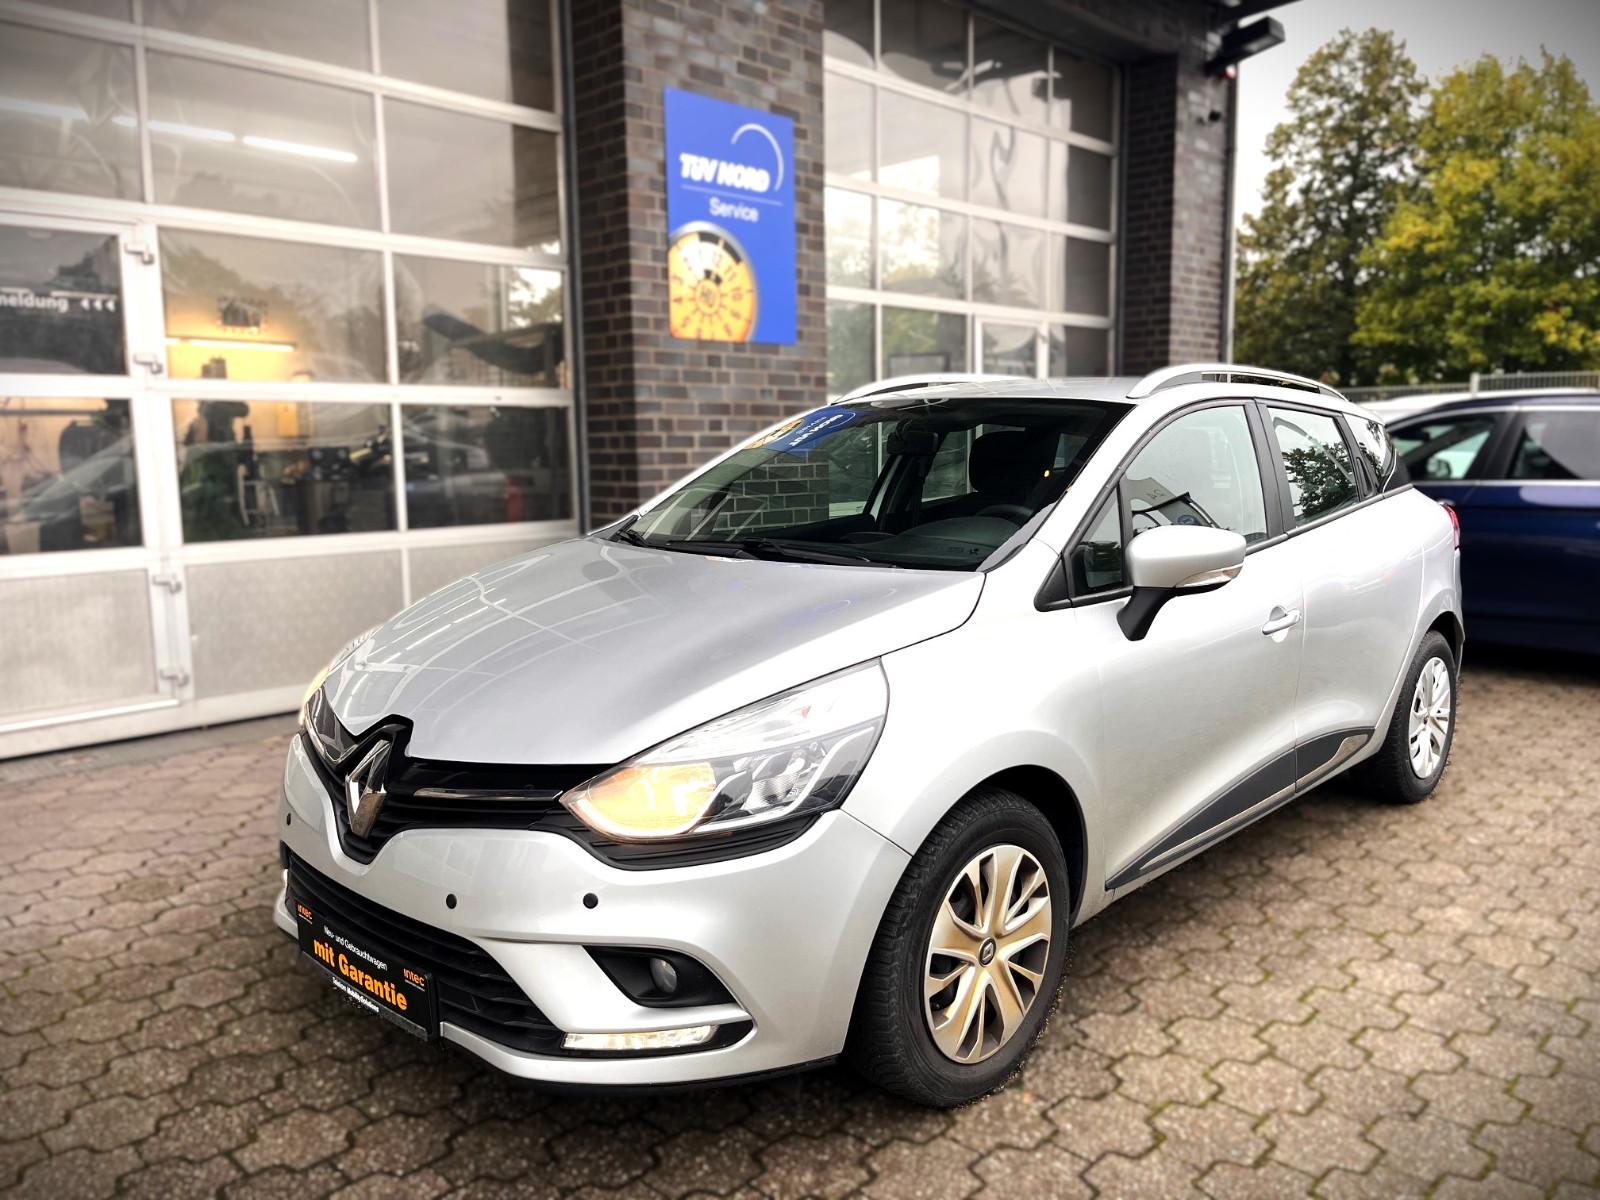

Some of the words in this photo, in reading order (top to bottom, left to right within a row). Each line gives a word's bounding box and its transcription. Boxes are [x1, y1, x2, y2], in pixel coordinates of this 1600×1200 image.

[717, 162, 770, 192] NORD
[709, 197, 759, 222] Service
[313, 938, 335, 967] mit
[338, 953, 408, 1011] Garantie
[403, 967, 425, 987] intec
